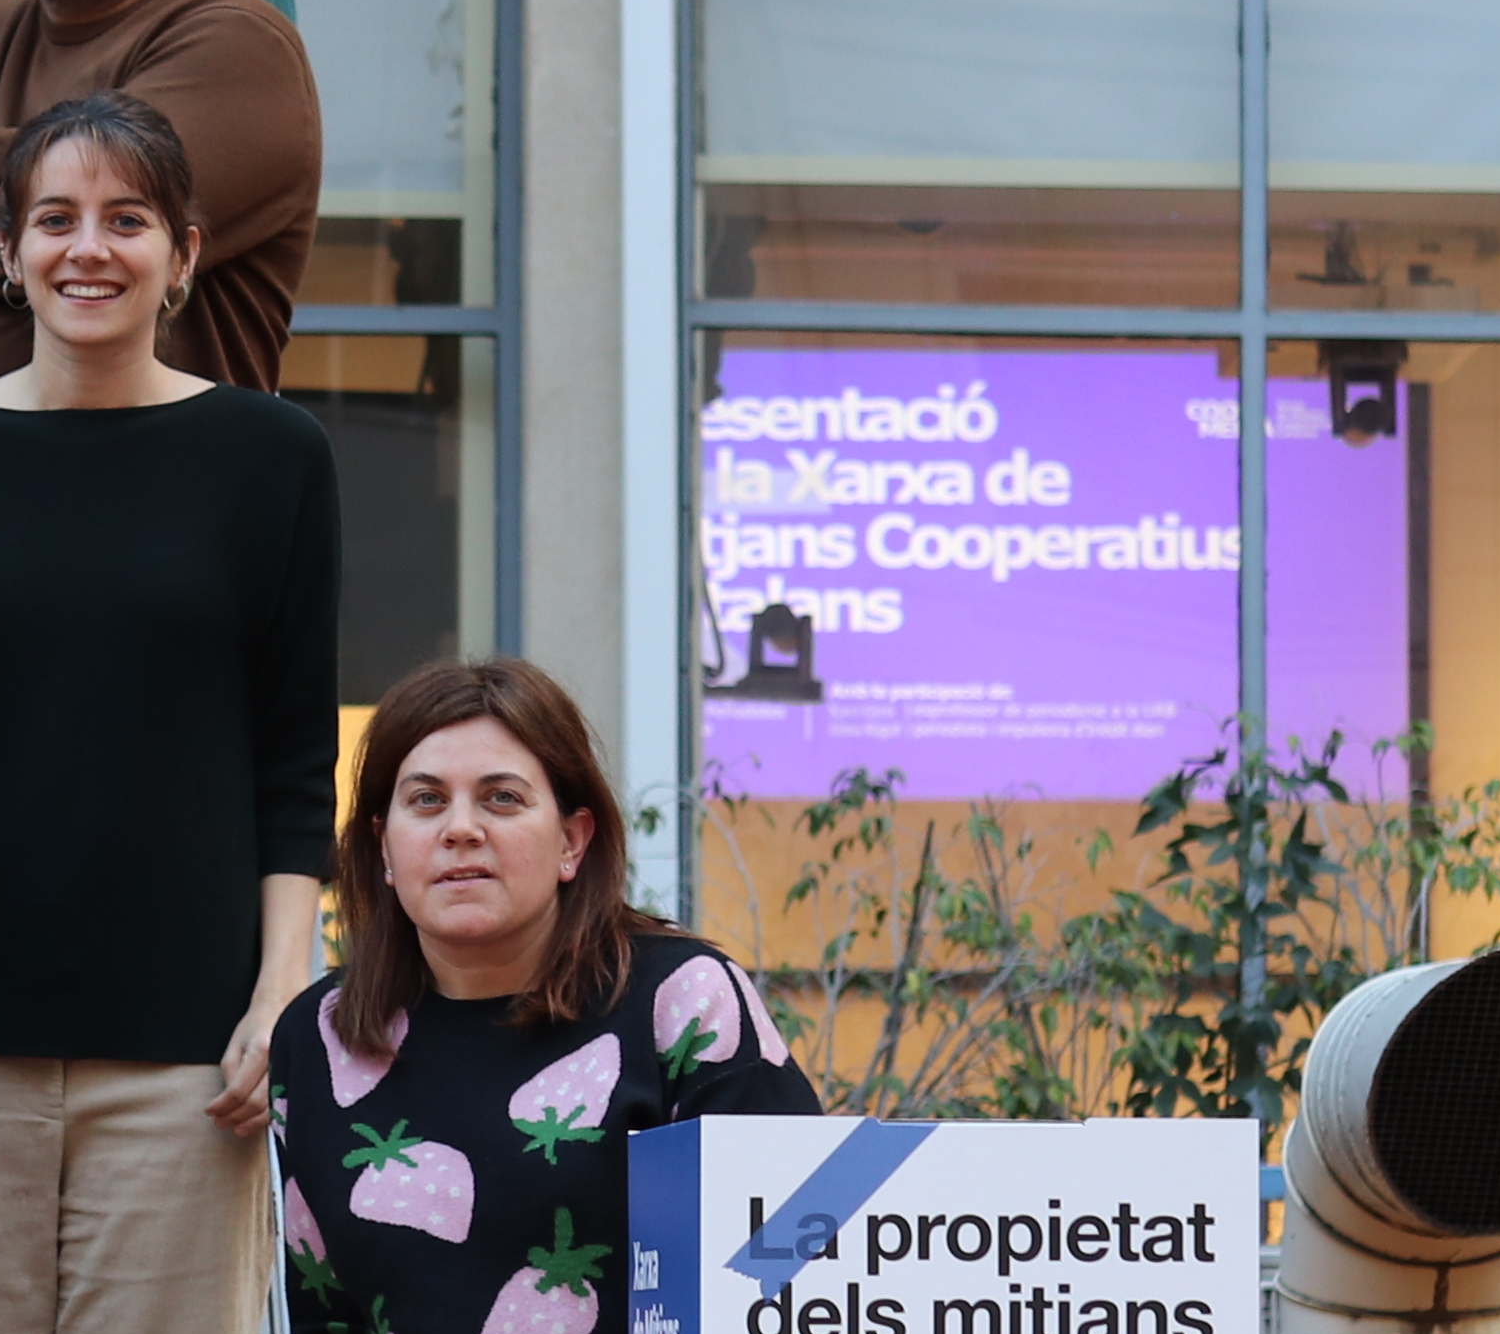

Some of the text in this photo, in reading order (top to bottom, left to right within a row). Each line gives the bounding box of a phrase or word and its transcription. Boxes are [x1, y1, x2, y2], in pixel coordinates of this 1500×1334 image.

[702, 380, 998, 442] esentació
[715, 446, 1071, 506] la Xarxa de
[702, 511, 1240, 583] tjans Cooperatius
[706, 575, 904, 634] talans
[633, 1241, 659, 1291] Xarxa
[749, 1198, 1216, 1276] La propietat
